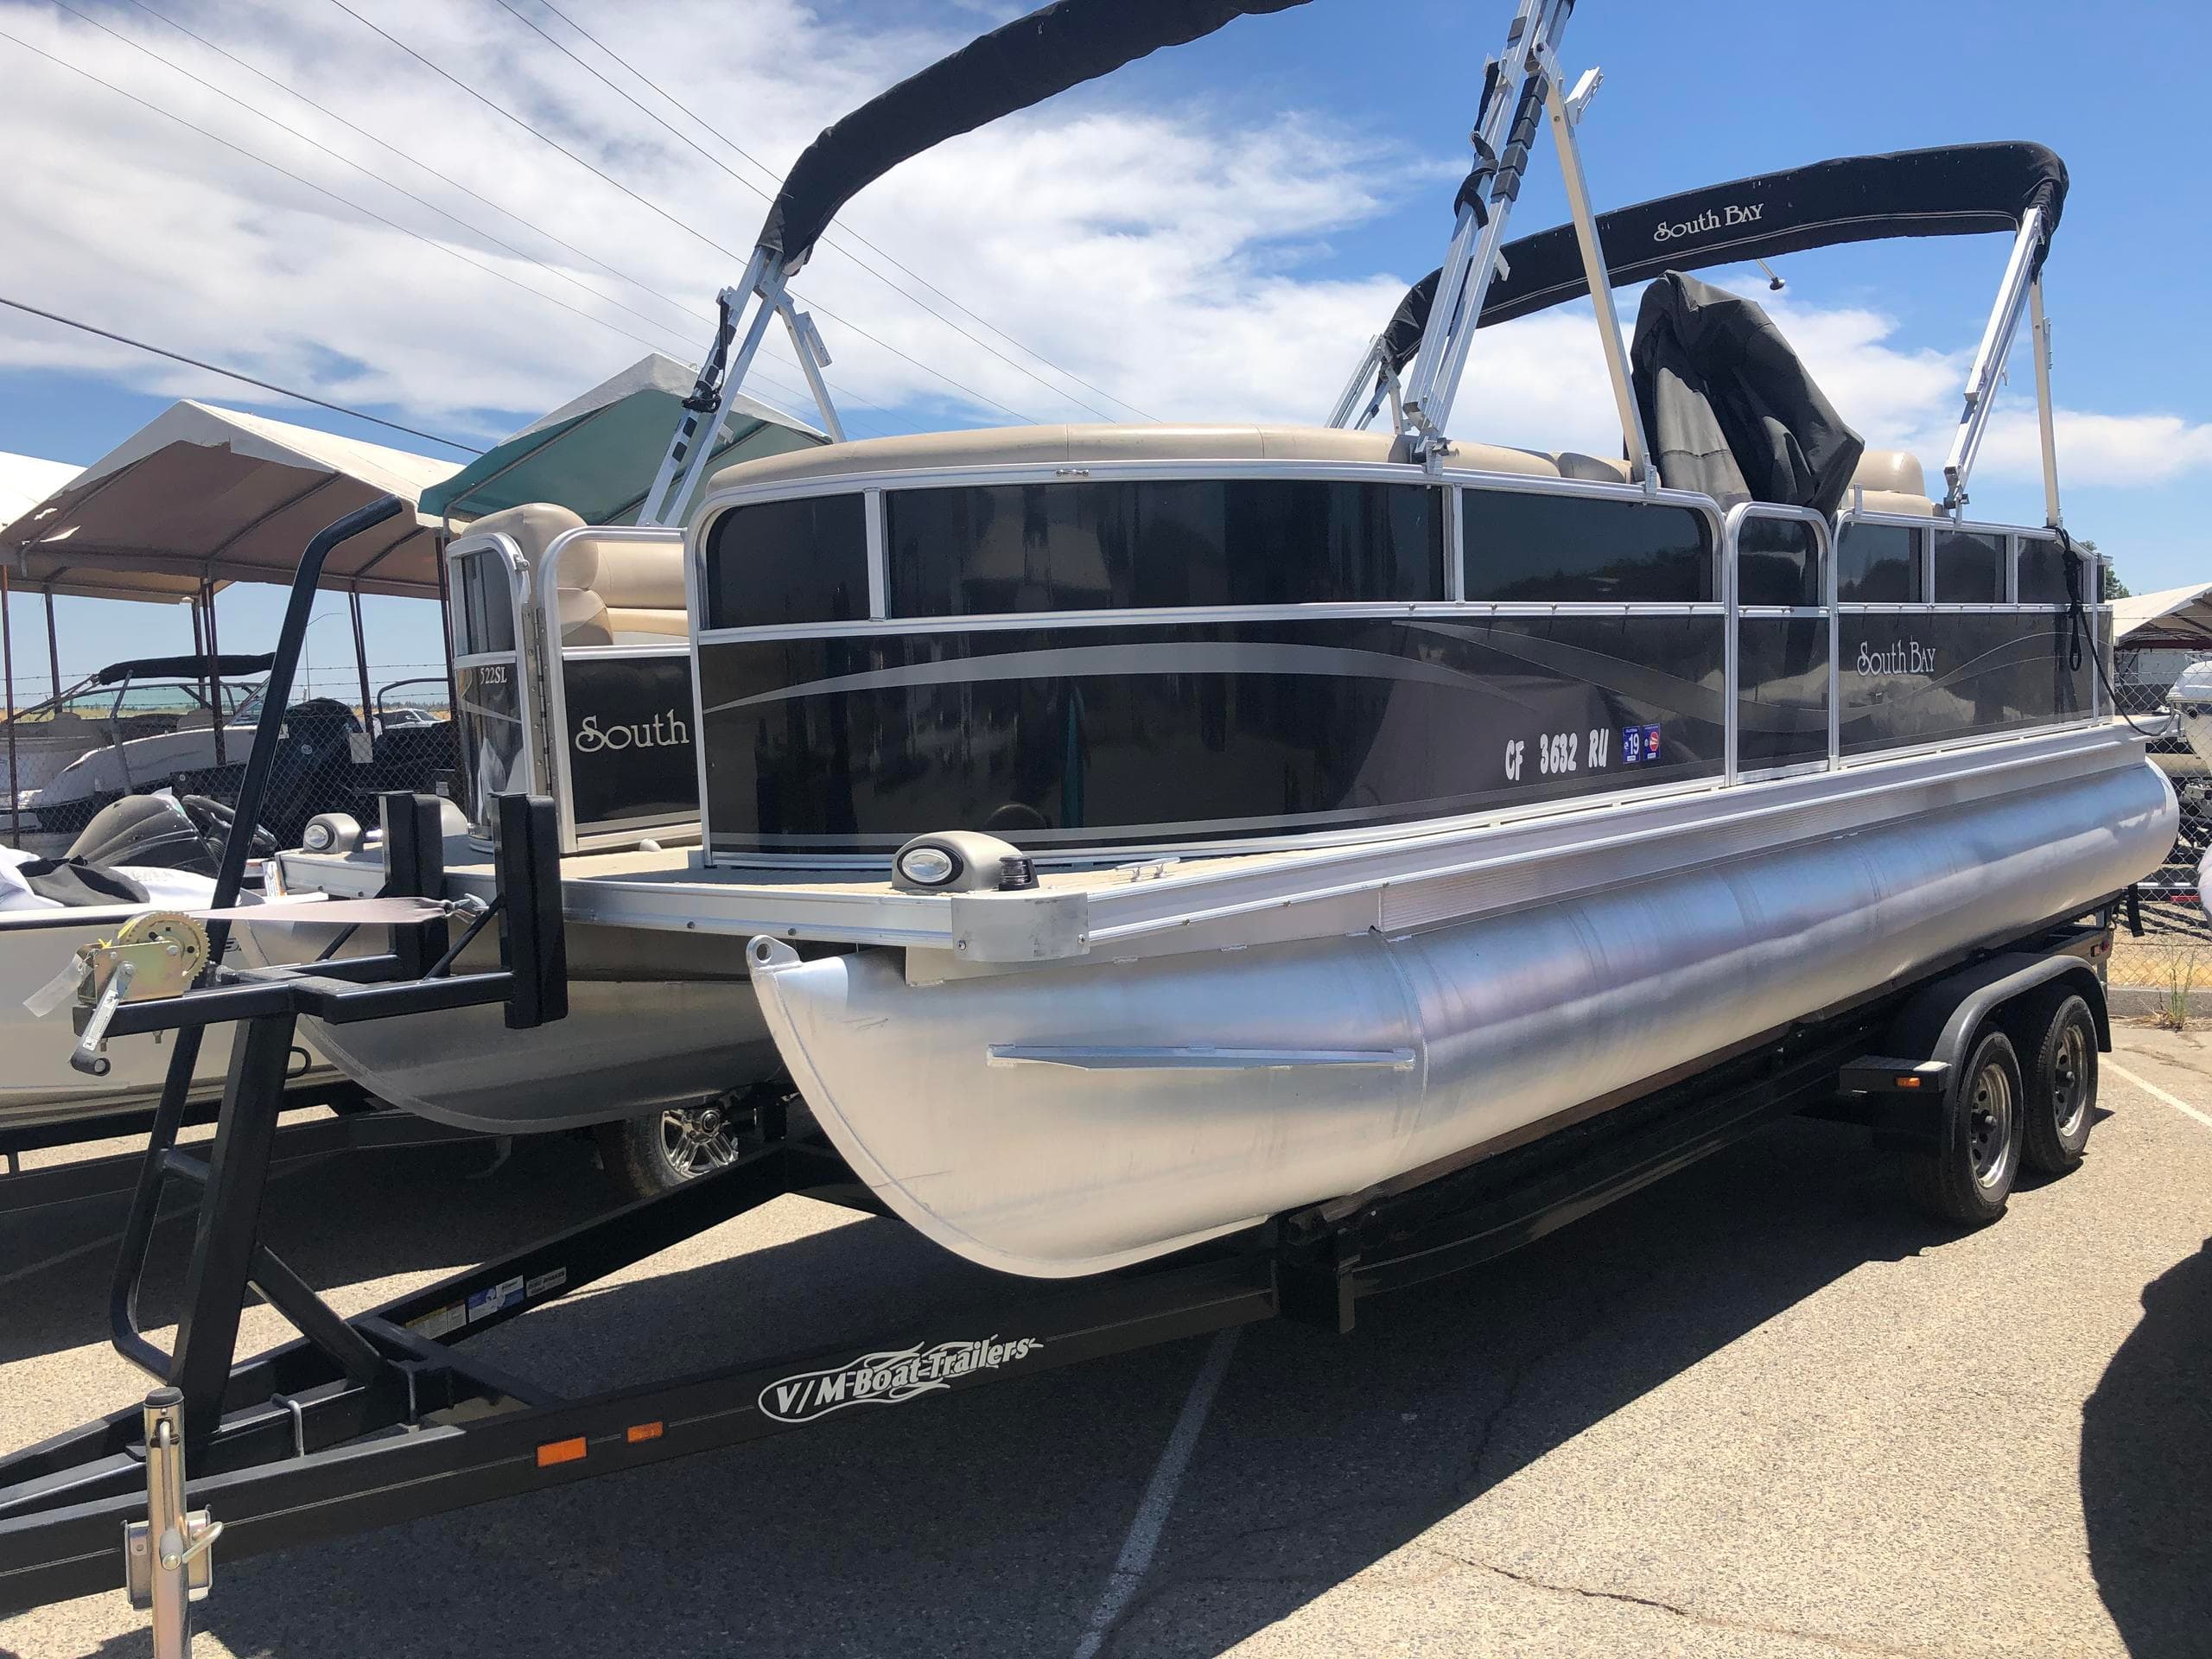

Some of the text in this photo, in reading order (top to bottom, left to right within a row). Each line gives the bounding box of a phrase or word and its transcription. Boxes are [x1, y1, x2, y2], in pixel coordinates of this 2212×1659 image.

[1654, 209, 1721, 241] South
[1857, 639, 1907, 676] South
[480, 666, 507, 684] 522SL
[575, 709, 690, 753] South
[1629, 733, 1639, 754] 19
[1505, 728, 1609, 780] CF 3632 RU
